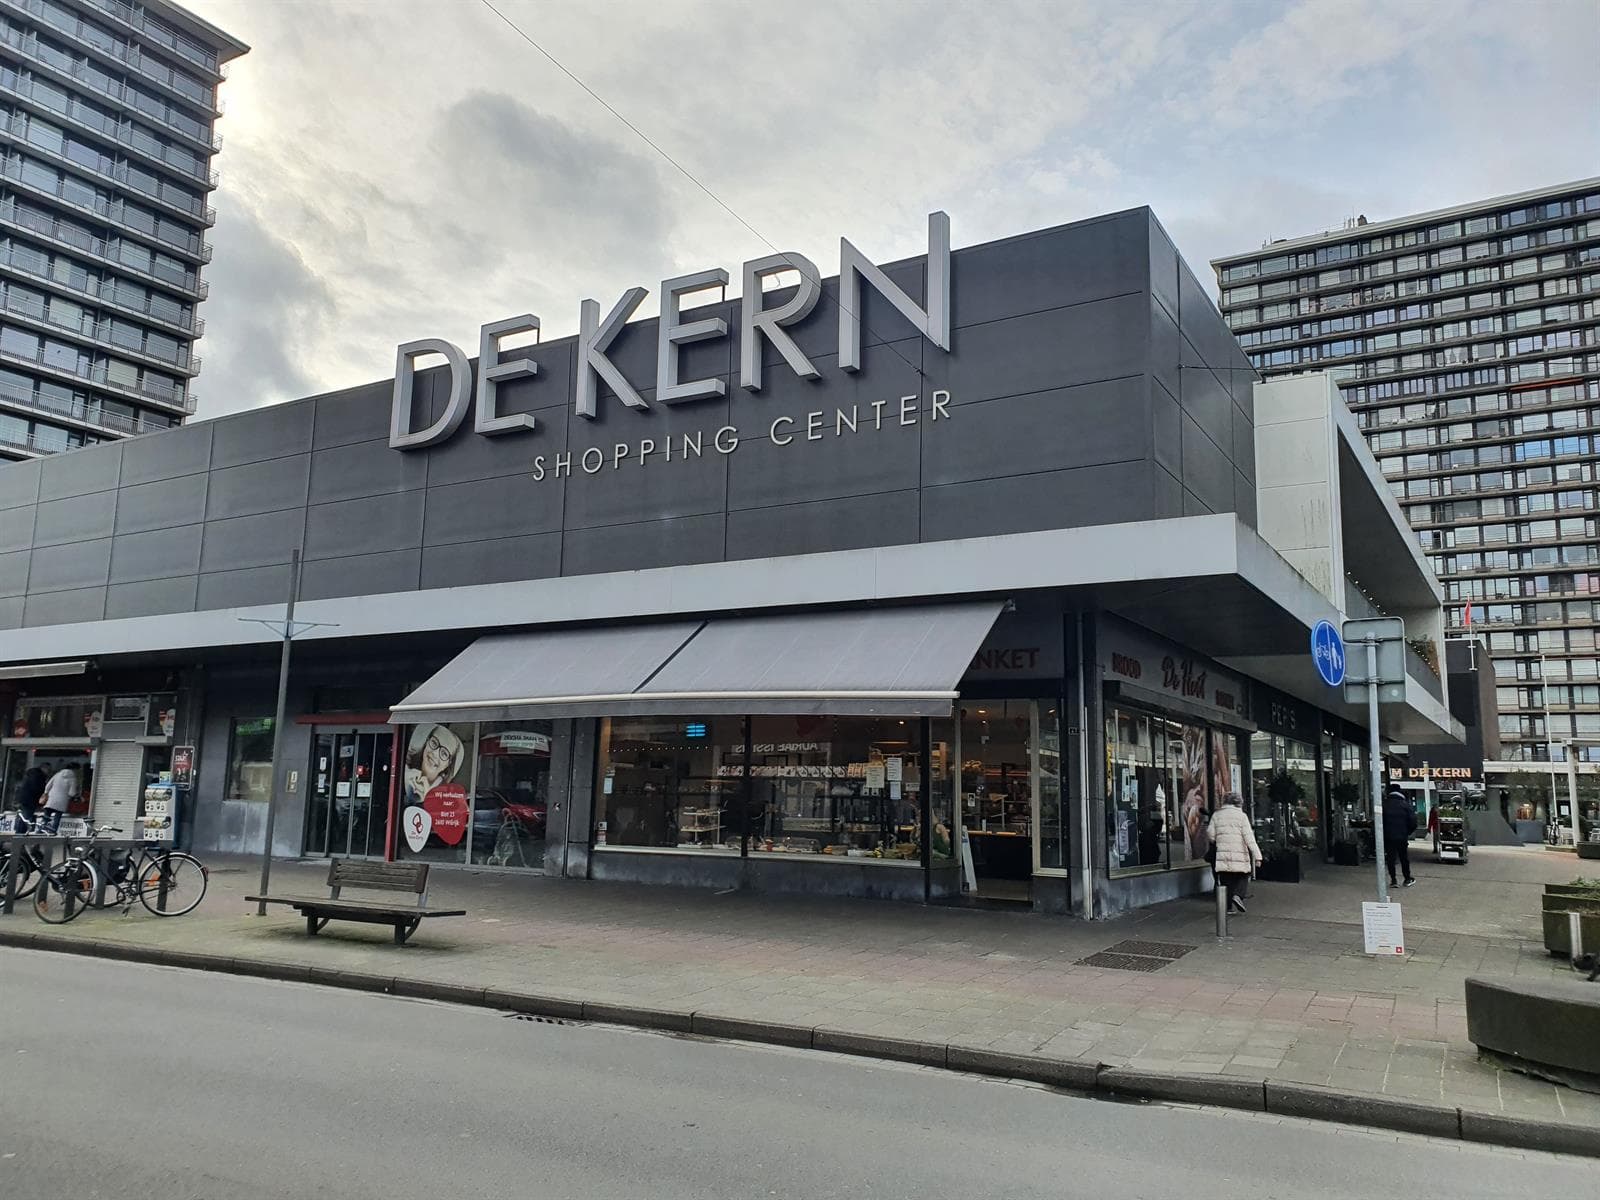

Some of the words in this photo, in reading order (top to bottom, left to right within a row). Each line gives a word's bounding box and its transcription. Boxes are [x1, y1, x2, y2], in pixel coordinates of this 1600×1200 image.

[388, 312, 541, 451] DE
[575, 210, 952, 419] KERN
[532, 425, 740, 482] SHOPPING
[769, 389, 952, 446] CENTER
[971, 647, 1041, 670] NKET
[1432, 767, 1472, 778] KERN
